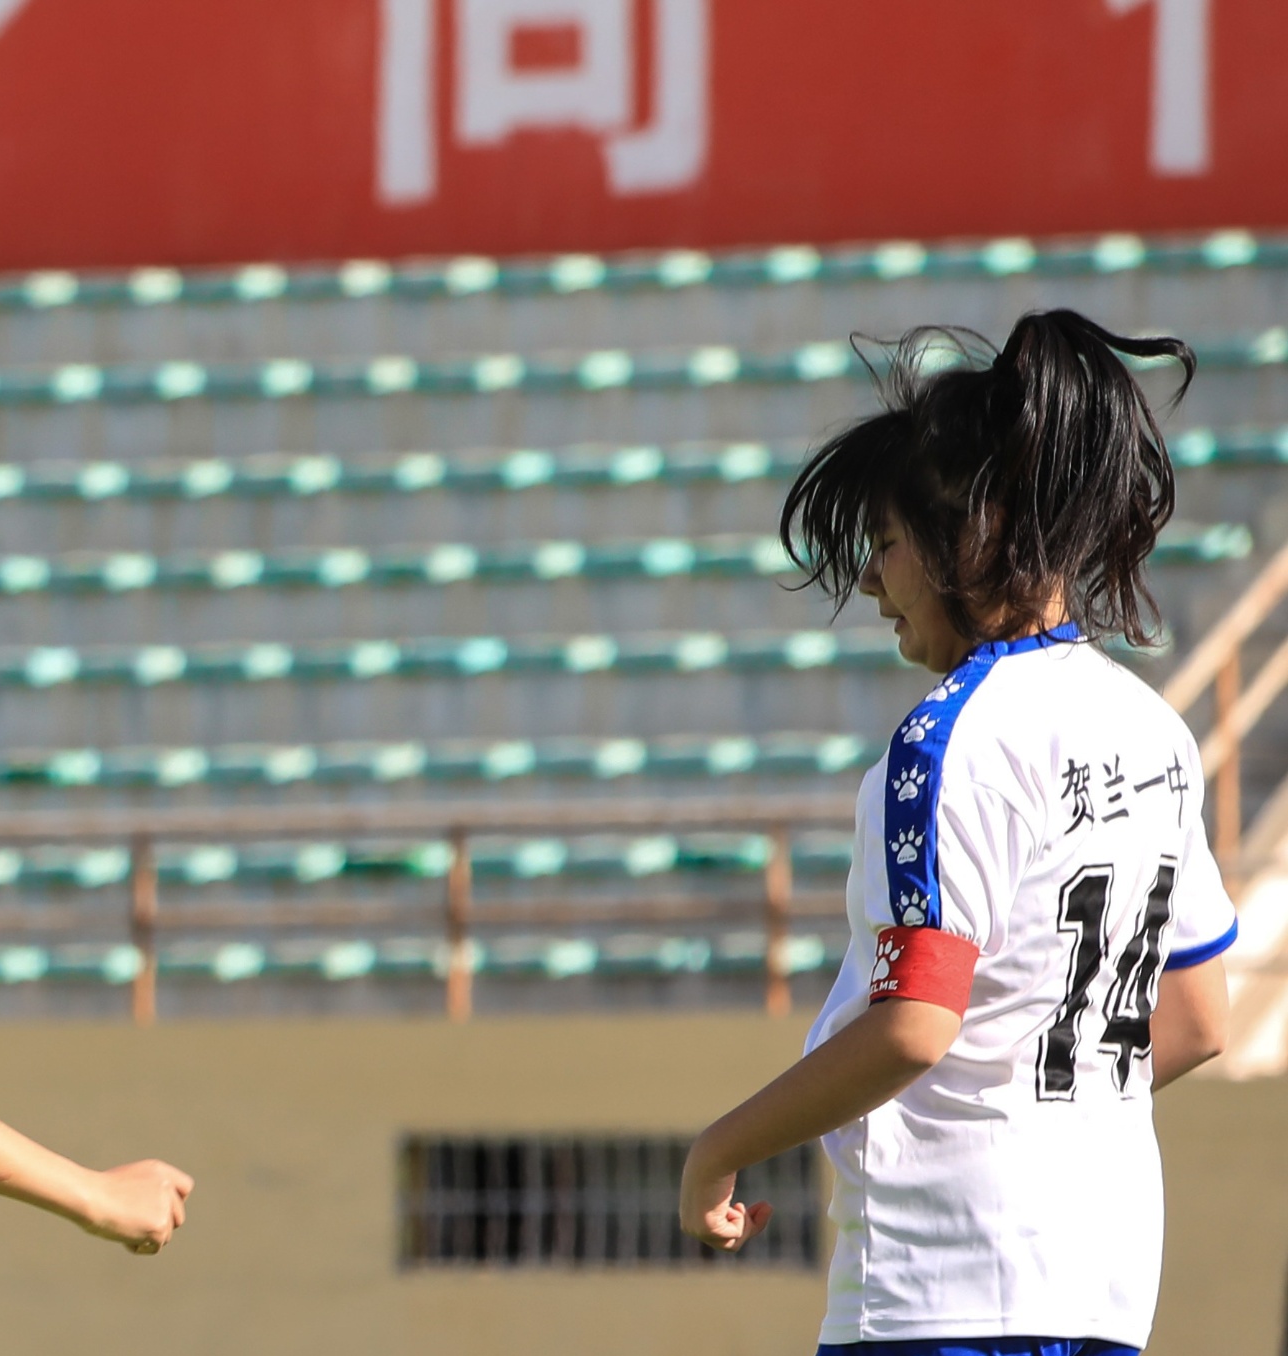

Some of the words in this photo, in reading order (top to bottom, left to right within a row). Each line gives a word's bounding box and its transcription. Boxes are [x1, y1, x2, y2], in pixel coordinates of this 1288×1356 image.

[1060, 747, 1190, 837] 贺兰一中
[1035, 853, 1179, 1103] 14
